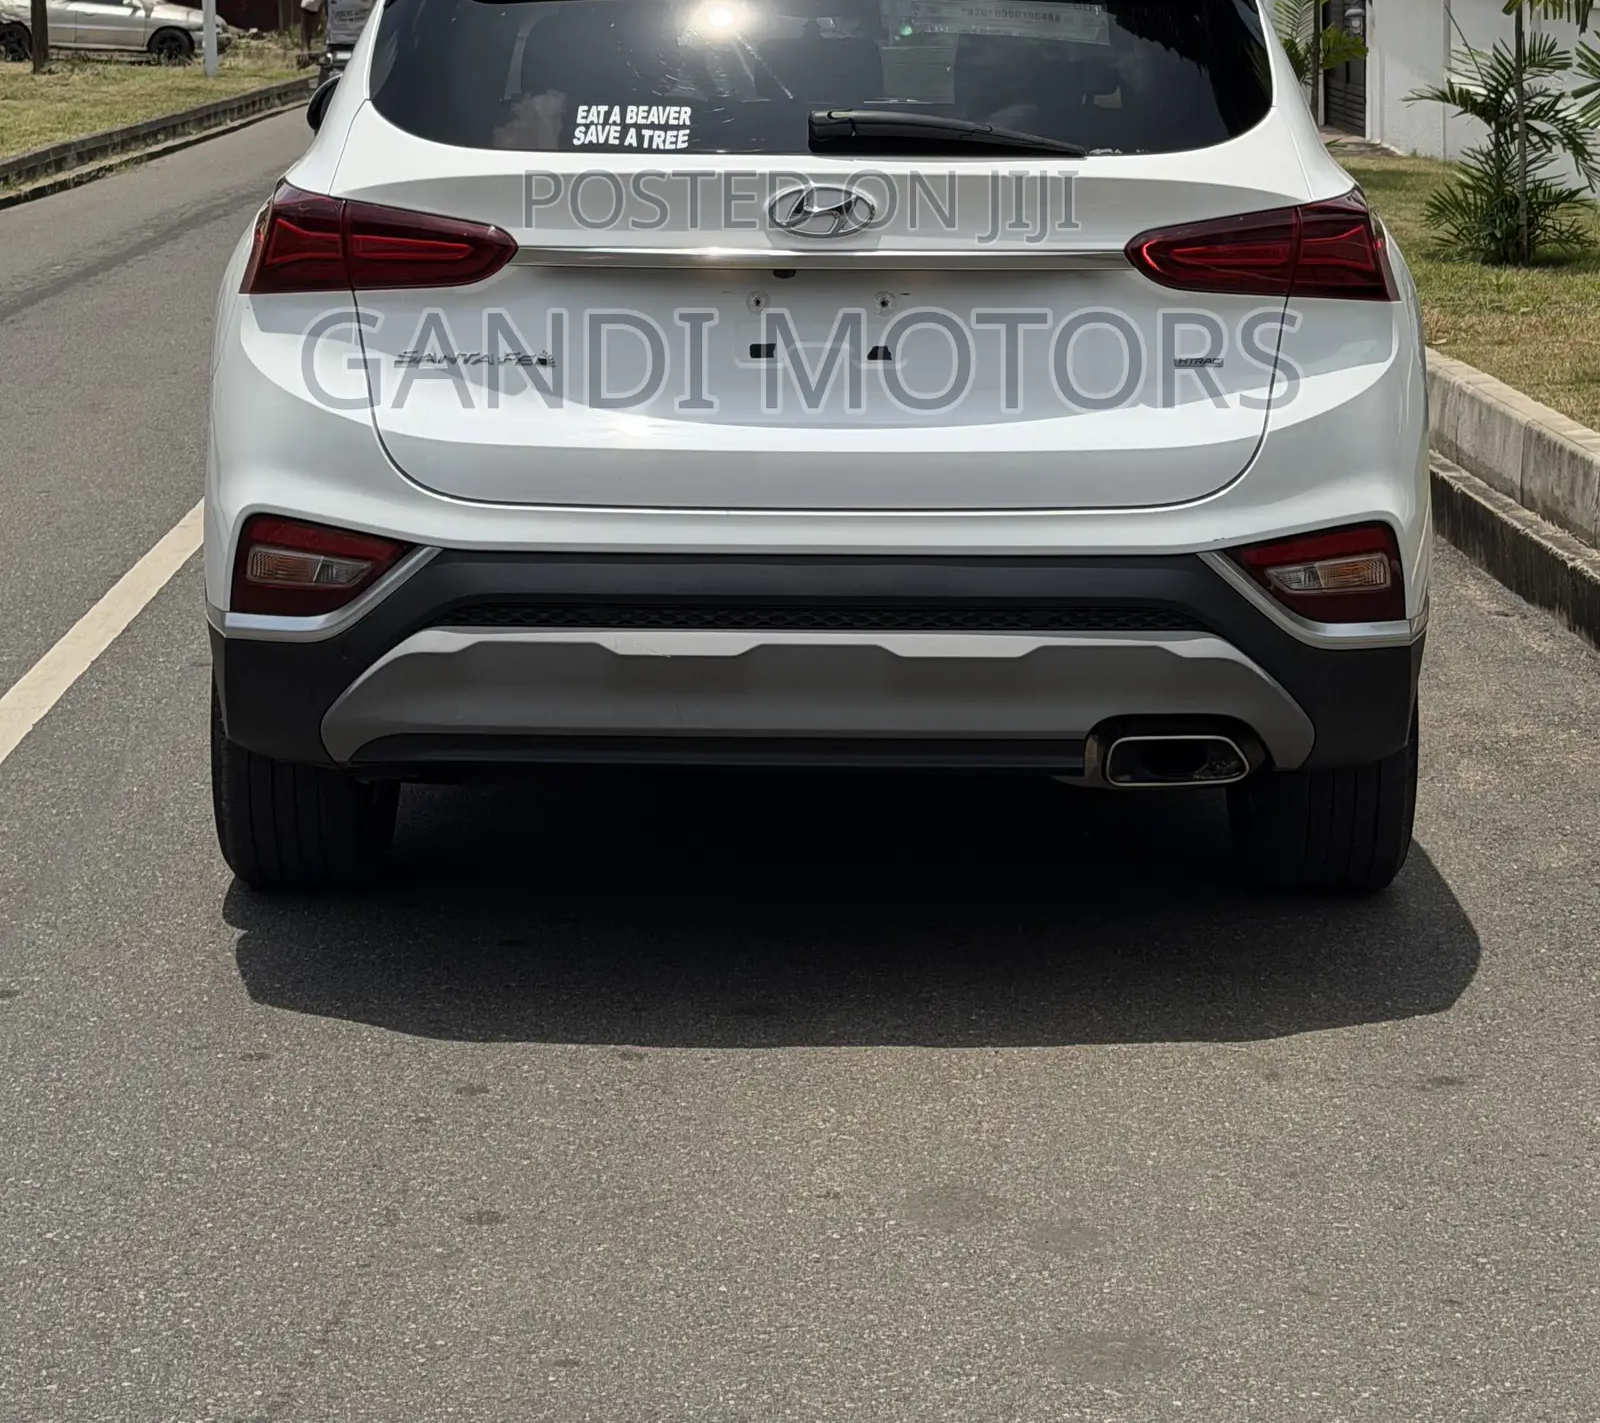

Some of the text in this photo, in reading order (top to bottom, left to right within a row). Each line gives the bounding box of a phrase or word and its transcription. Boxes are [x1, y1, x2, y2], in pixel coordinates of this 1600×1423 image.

[576, 105, 692, 126] EAT A BEAVER
[573, 125, 691, 150] SAVE A TREE
